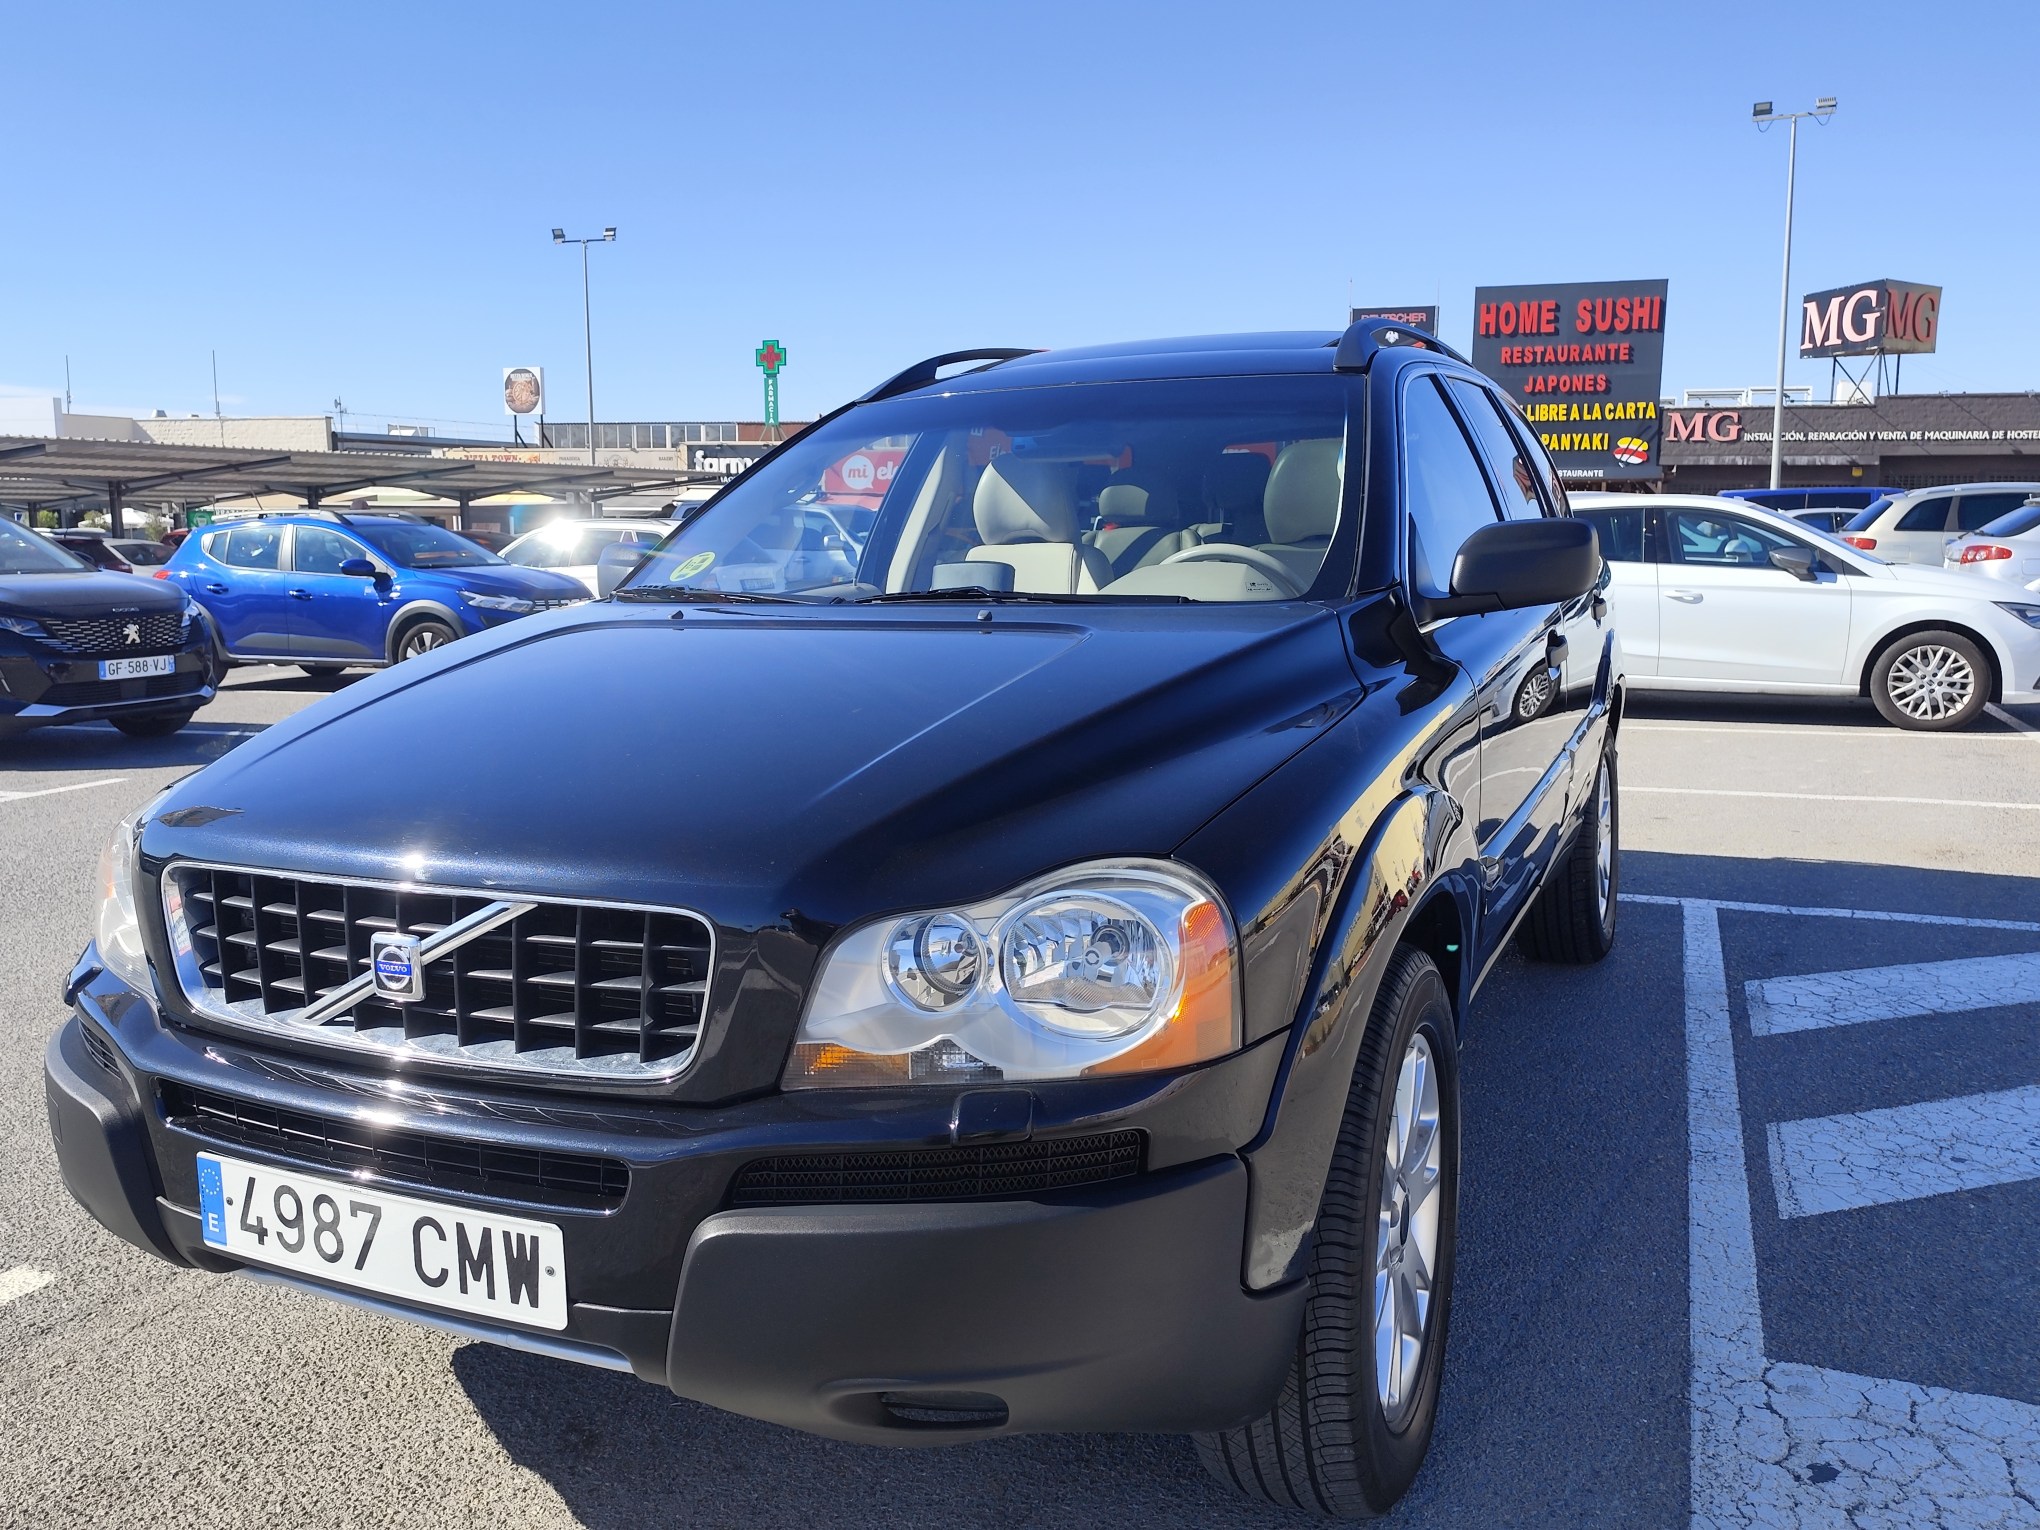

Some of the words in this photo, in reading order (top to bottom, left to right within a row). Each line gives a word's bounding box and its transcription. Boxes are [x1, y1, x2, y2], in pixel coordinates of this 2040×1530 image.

[1479, 300, 1557, 335] HOME
[1575, 295, 1661, 333] SUSHI
[1800, 289, 1881, 350] MG
[1885, 288, 1937, 343] MG
[1501, 342, 1631, 364] RESTAURANTE
[1524, 374, 1607, 393] JAPONES
[767, 379, 775, 424] FARMACIA
[1527, 403, 1567, 421] LIBRE
[1570, 403, 1580, 421] A
[1583, 402, 1602, 420] LA
[1604, 401, 1657, 420] CARTA
[1665, 411, 1743, 442] MG
[1744, 430, 1806, 442] INSTALCIÓN,
[1808, 430, 1867, 441] REPARACIÓN
[1869, 431, 1877, 440] Y
[1877, 431, 1908, 440] VENTA
[1909, 431, 1922, 440] DE
[1924, 431, 1990, 440] MAQUINARIA
[1992, 431, 2005, 440] DE
[1541, 432, 1610, 450] PANYAKI
[848, 464, 869, 479] mi
[1557, 469, 1604, 477] STAURANTE
[378, 963, 408, 973] VOLVO
[208, 1212, 220, 1233] E
[240, 1176, 382, 1271] 4987
[412, 1216, 540, 1309] CMW
